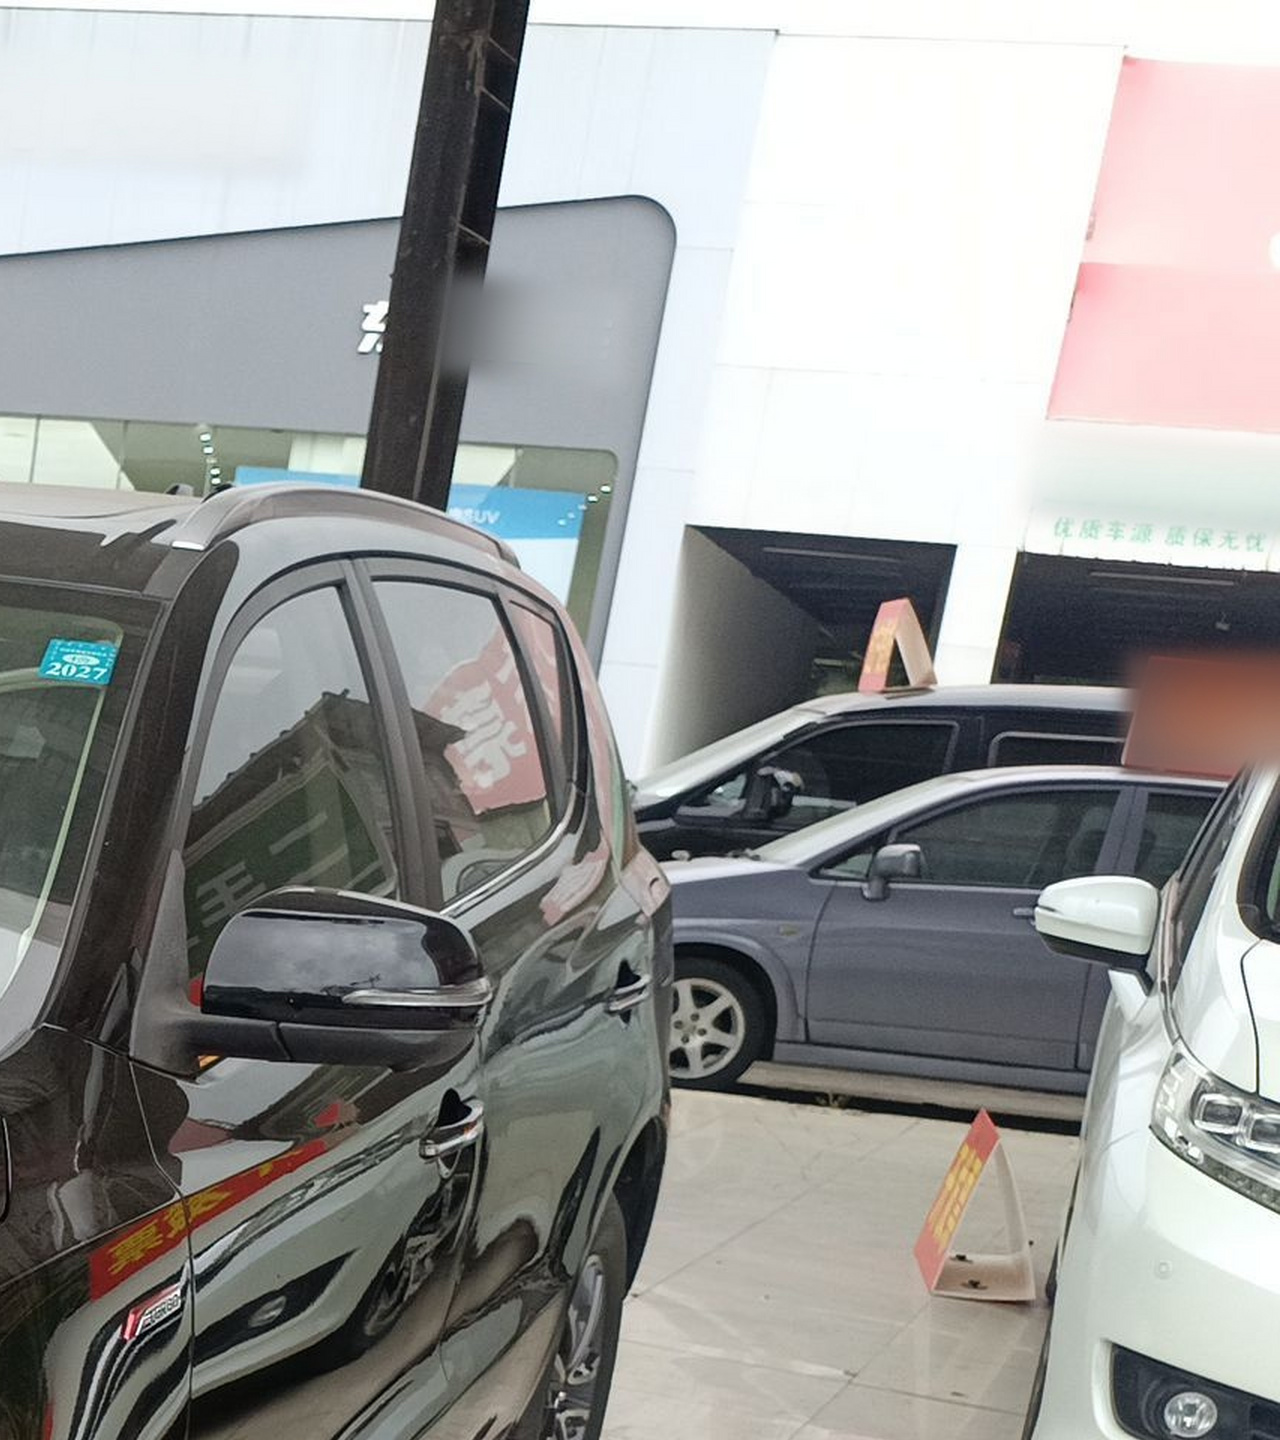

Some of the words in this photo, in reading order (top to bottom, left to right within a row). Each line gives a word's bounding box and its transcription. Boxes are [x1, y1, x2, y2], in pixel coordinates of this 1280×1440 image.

[1054, 517, 1154, 543] 优质车源
[1165, 525, 1267, 552] 质保无忧
[45, 661, 108, 680] 2027
